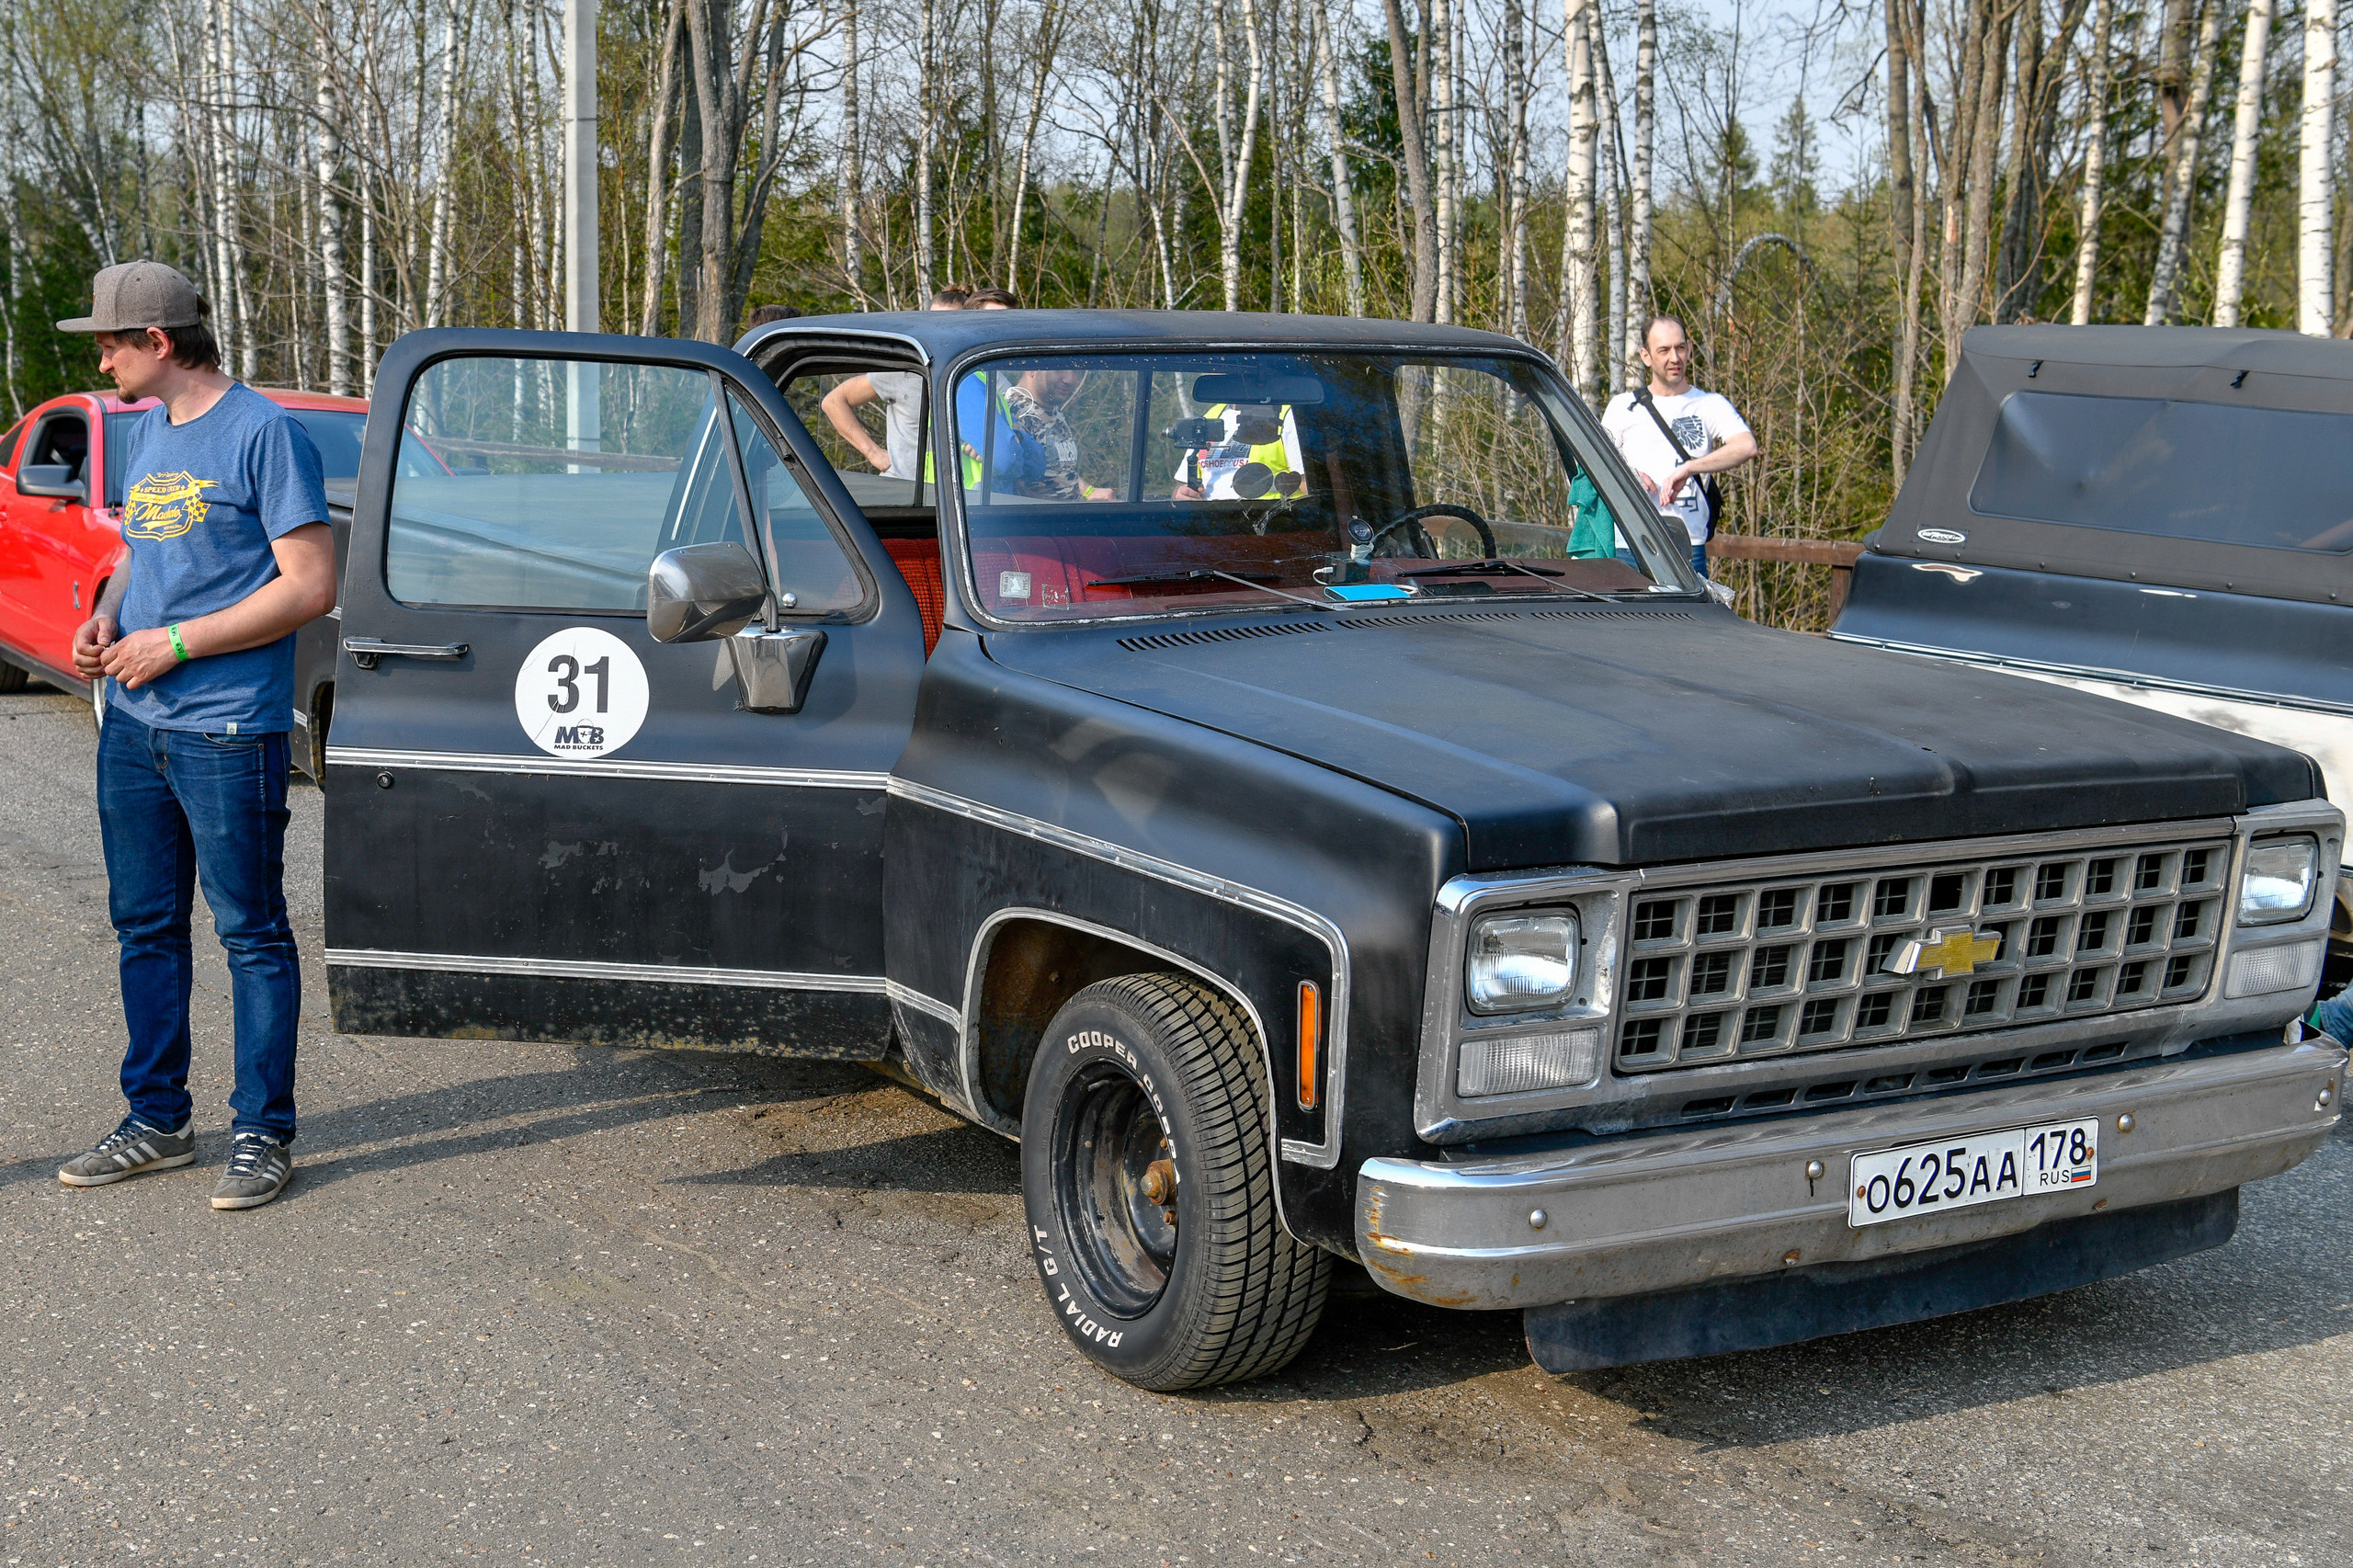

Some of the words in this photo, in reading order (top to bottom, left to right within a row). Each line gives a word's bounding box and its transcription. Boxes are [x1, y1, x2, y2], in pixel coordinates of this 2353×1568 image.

[547, 654, 609, 713] 31
[1067, 1030, 1139, 1070] COOPER
[2029, 1127, 2086, 1171] 178
[2040, 1170, 2070, 1187] RUS
[1033, 1224, 1059, 1276] G/T
[1057, 1282, 1123, 1348] RADIAL
